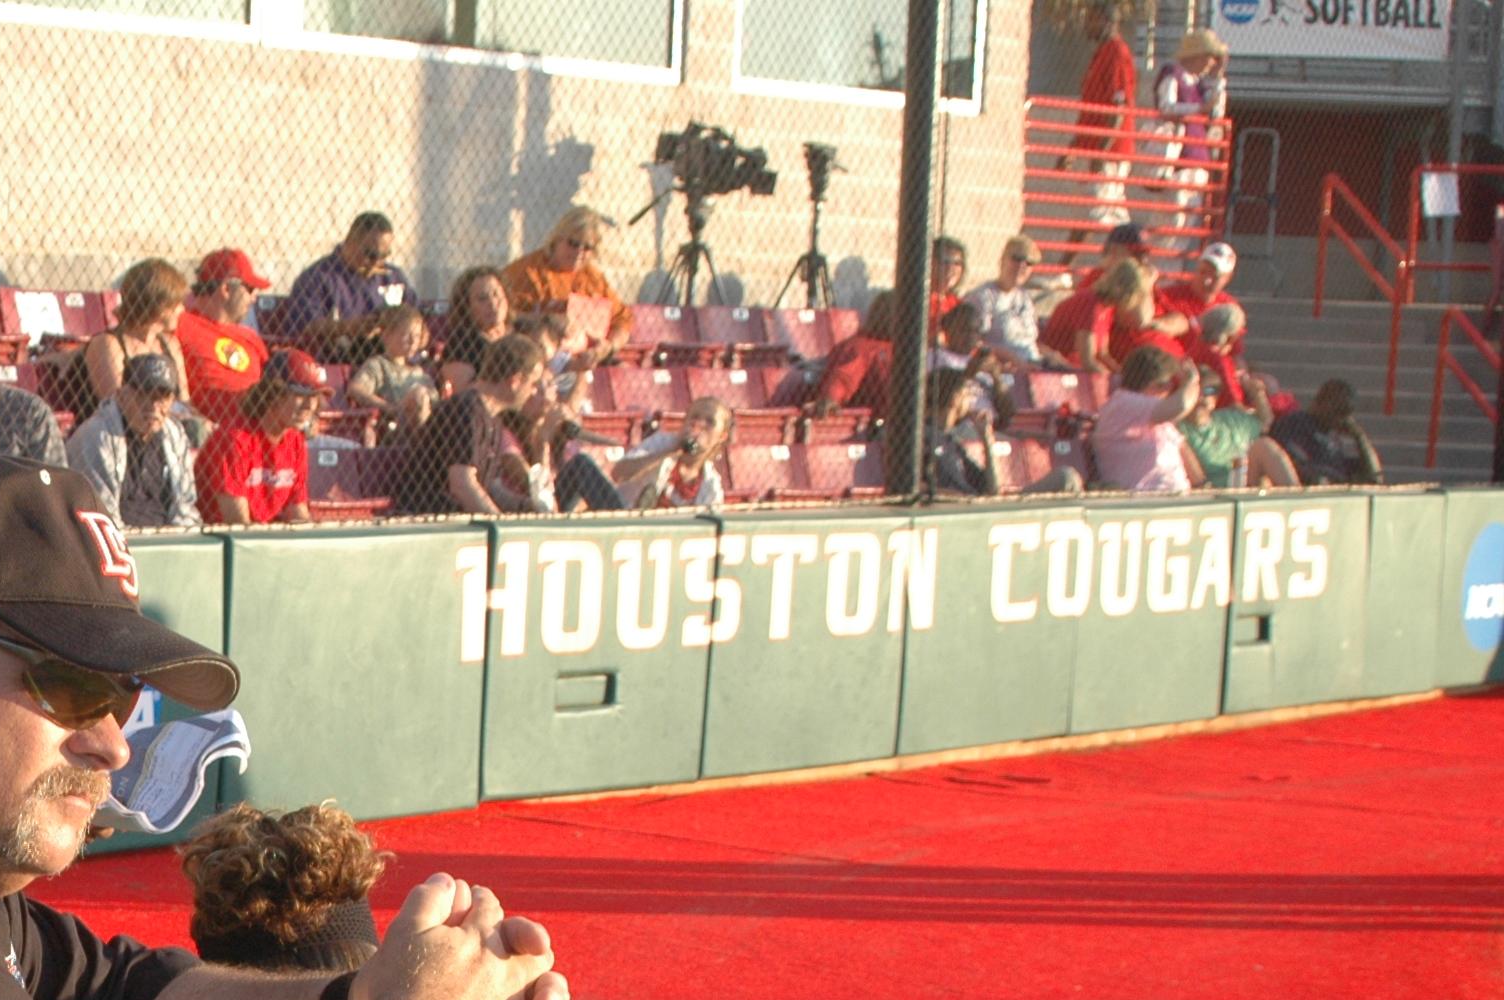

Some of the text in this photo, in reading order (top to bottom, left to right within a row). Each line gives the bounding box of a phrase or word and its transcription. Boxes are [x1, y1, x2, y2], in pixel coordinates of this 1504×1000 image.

[1304, 0, 1442, 29] SOFTBALL
[454, 507, 1331, 664] HOUSTON COUGARS
